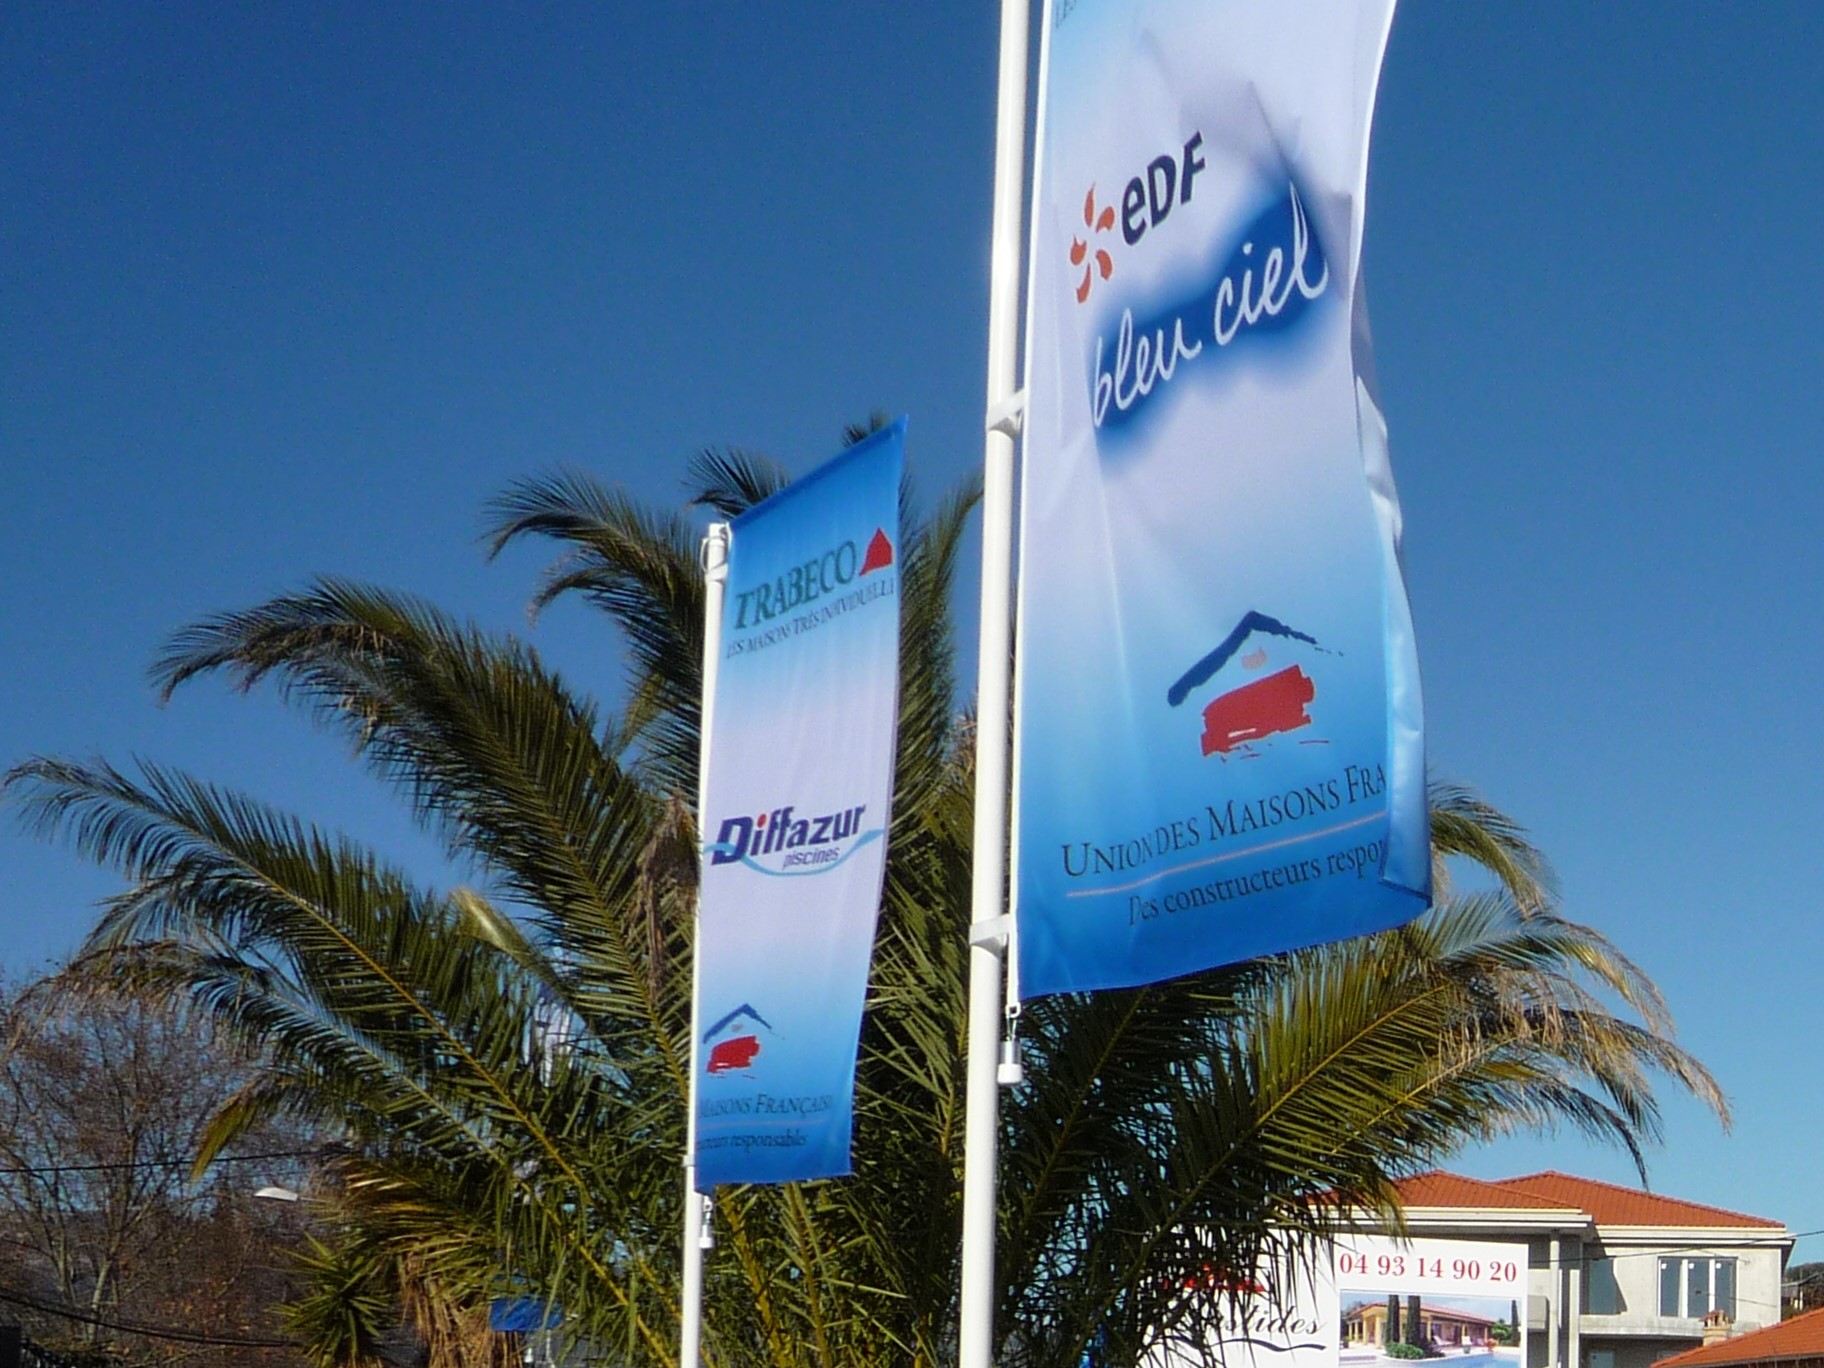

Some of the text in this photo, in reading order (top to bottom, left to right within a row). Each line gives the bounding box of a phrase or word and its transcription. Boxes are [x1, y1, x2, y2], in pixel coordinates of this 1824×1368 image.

[1214, 180, 1329, 347] ciel
[735, 540, 857, 630] TRABECO
[711, 804, 867, 866] Diffazur
[1061, 762, 1387, 877] UNION DES MAISONS FRA
[781, 847, 840, 872] piscines
[1163, 857, 1323, 914] constructeurs
[1339, 1253, 1518, 1283] 04 93 14 90 20
